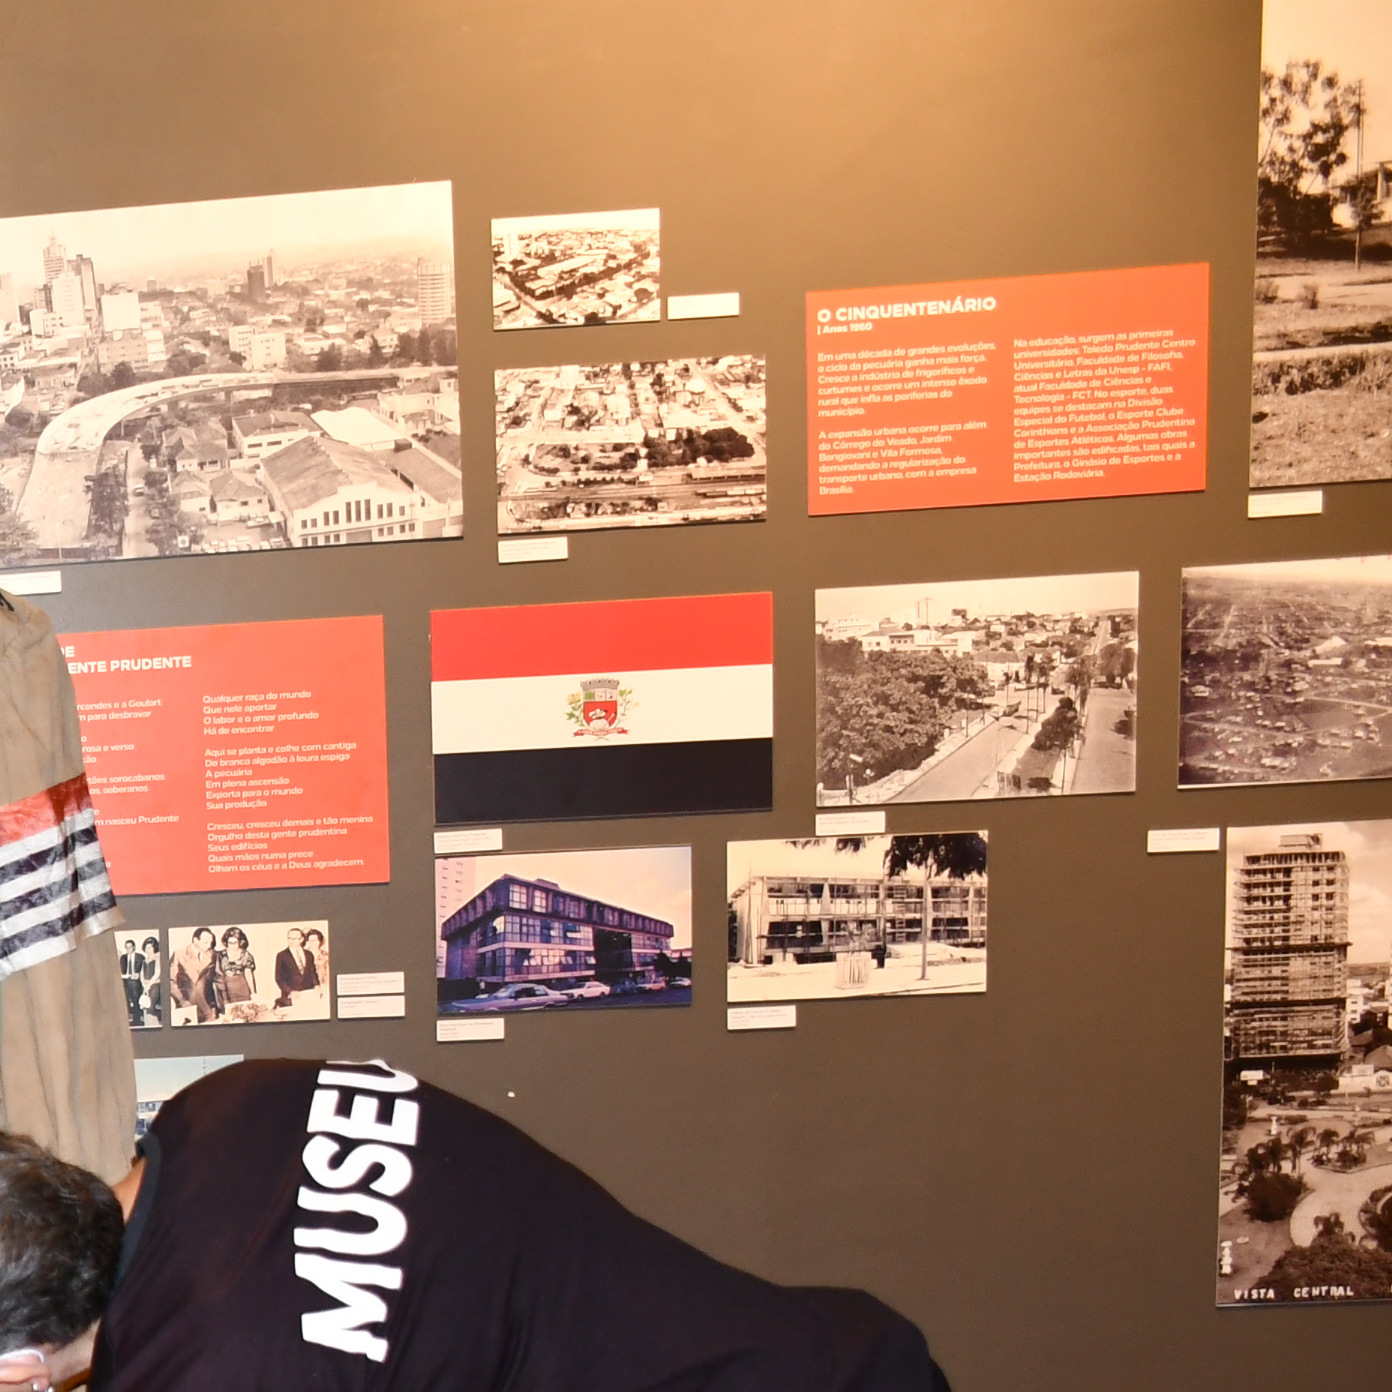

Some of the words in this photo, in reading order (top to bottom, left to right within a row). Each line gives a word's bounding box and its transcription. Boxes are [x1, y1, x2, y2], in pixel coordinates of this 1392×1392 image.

[835, 296, 997, 321] CINQUENTENÁRIO
[822, 324, 848, 334] Anos
[849, 321, 873, 332] 1960
[110, 656, 192, 672] PRUDENTE
[128, 698, 162, 708] Goulart
[202, 694, 244, 704] Qualquer
[245, 694, 265, 703] raça
[265, 691, 278, 700] do
[279, 690, 312, 699] mundo
[202, 705, 223, 715] Que
[223, 704, 243, 713] nele
[244, 703, 277, 714] aportar
[87, 713, 108, 723] para
[108, 711, 152, 720] desbravar
[212, 715, 236, 725] labor
[252, 714, 277, 723] amor
[277, 711, 319, 723] profundo
[203, 726, 217, 736] Há
[217, 726, 230, 735] de
[231, 725, 275, 734] encontrar
[204, 748, 226, 758] Aqui
[226, 748, 238, 756] se
[238, 746, 267, 757] planta
[275, 744, 300, 753] colhe
[301, 744, 322, 752] com
[322, 742, 357, 751] cantiga
[204, 759, 219, 768] Do
[219, 758, 251, 767] branco
[251, 755, 288, 766] algodão
[296, 754, 319, 763] loura
[320, 753, 350, 762] espiga
[214, 768, 253, 779] pecuária
[205, 780, 221, 789] Em
[222, 779, 247, 789] plena
[247, 776, 290, 787] ascensão
[205, 790, 241, 800] Exporta
[241, 790, 263, 799] para
[271, 786, 304, 796] mundo
[206, 801, 224, 810] Sua
[224, 799, 268, 810] produção
[293, 1059, 419, 1363] MUSEU
[1233, 1287, 1276, 1300] VISTA
[1293, 1285, 1355, 1299] CENTRAL
